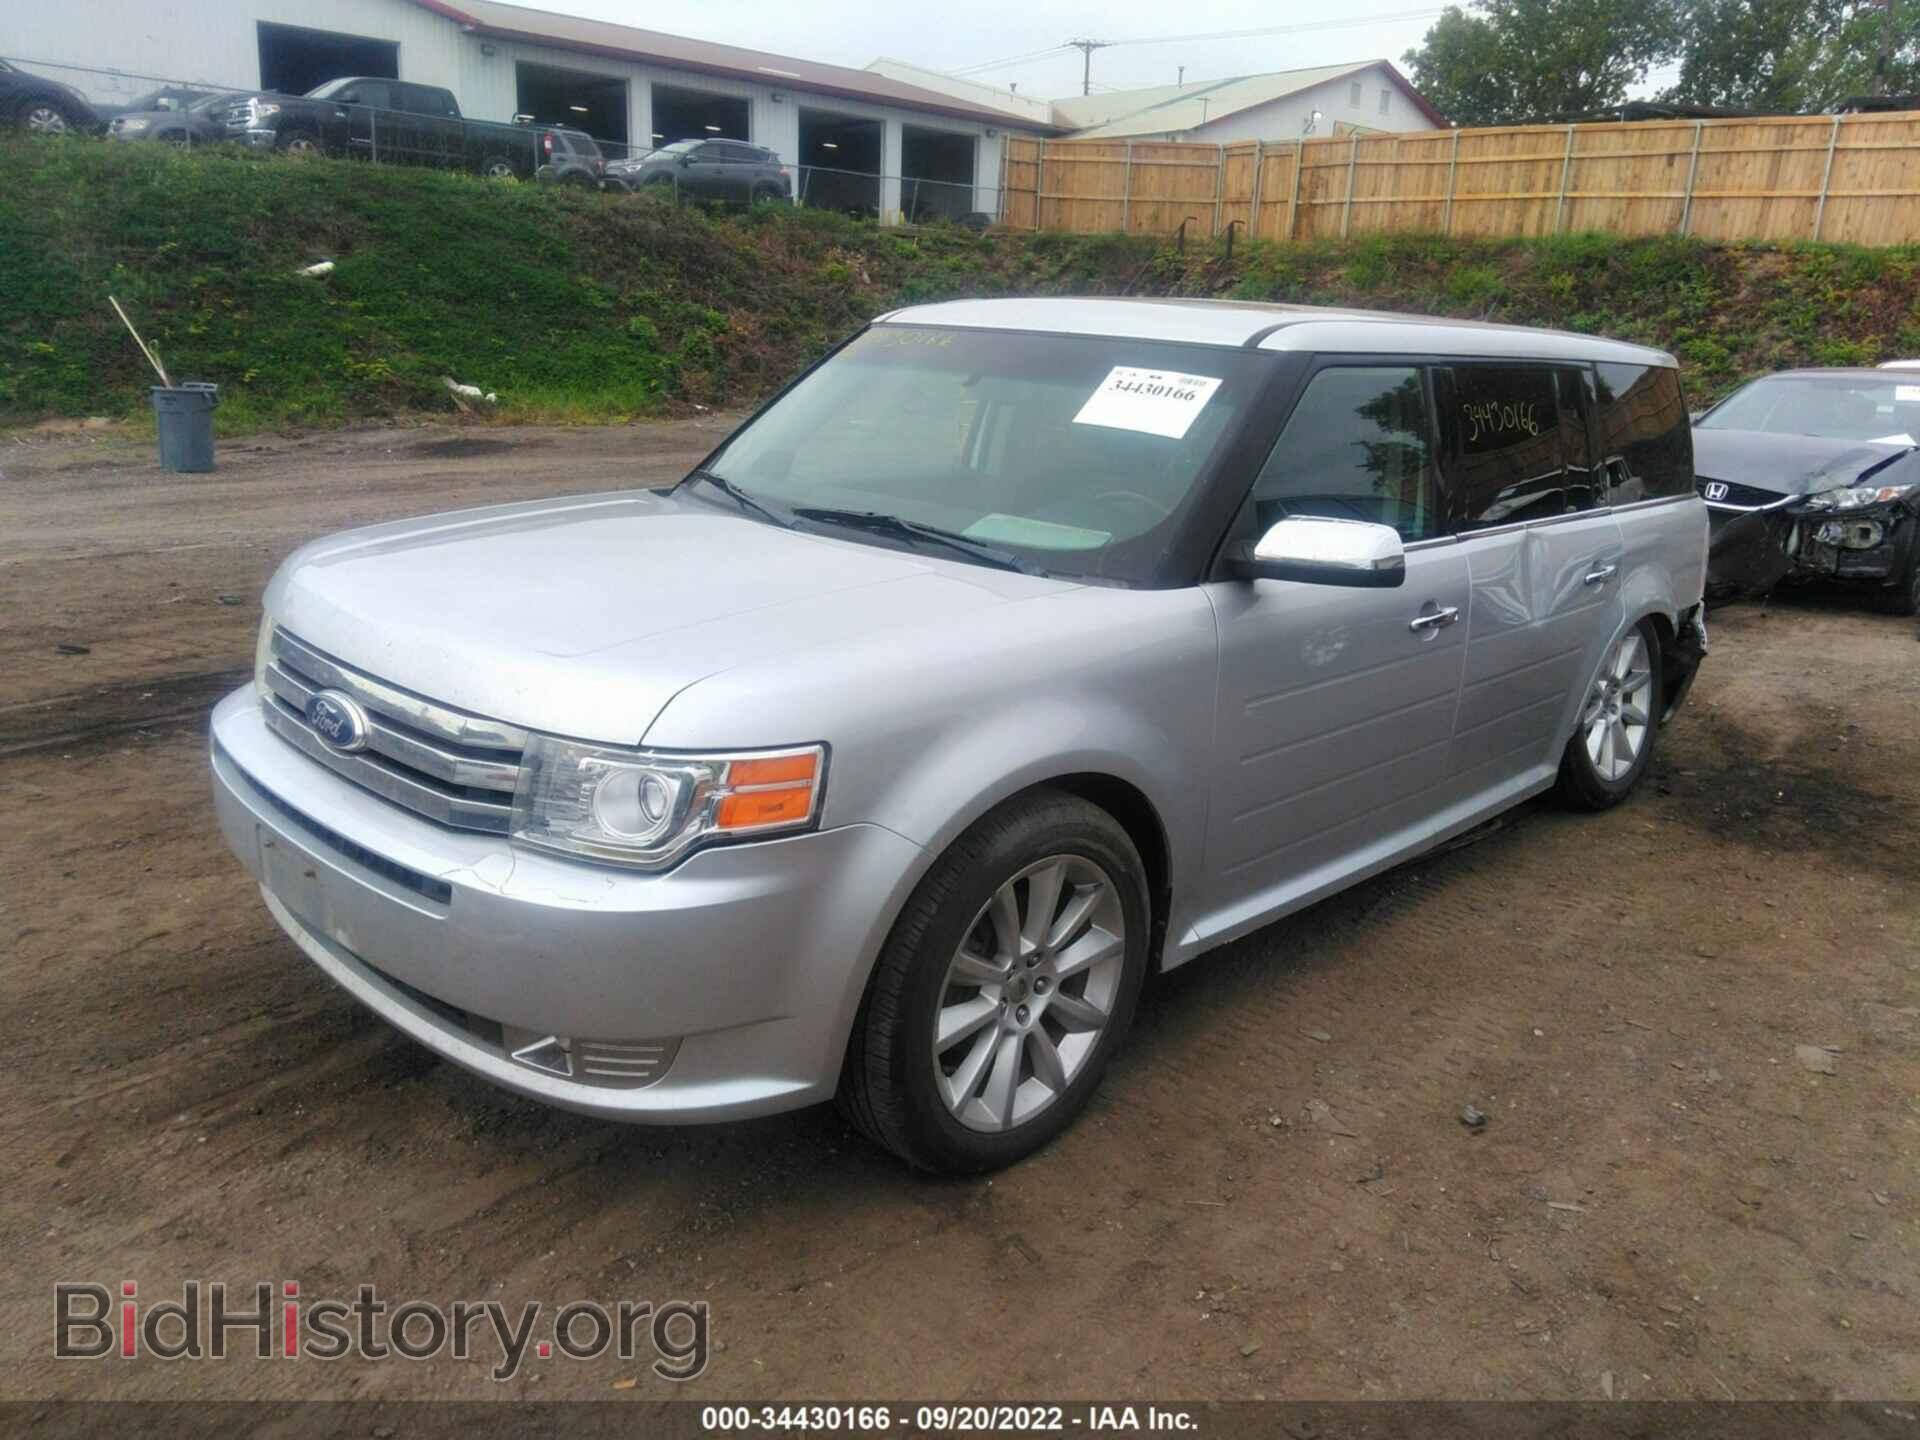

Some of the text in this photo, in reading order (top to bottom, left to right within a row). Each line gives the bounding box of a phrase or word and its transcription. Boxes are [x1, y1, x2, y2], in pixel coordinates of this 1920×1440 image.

[1108, 379, 1197, 402] 34430166
[1463, 401, 1539, 441] 34430166
[311, 700, 344, 738] Ford
